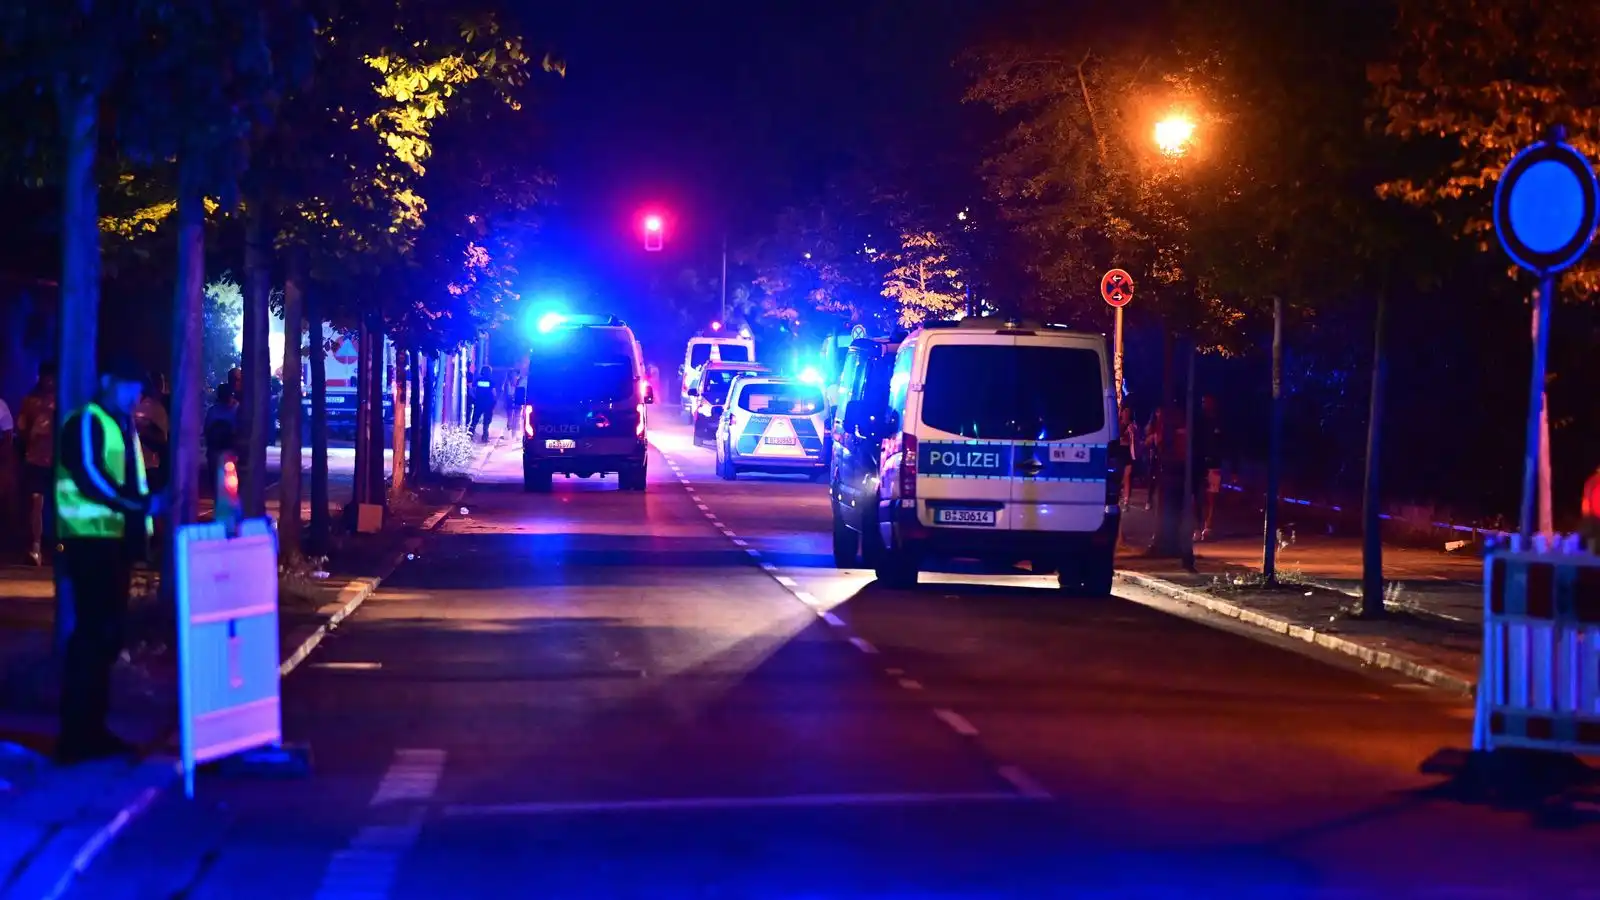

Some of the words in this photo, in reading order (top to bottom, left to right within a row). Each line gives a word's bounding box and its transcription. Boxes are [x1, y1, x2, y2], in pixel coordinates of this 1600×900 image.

[539, 424, 579, 433] POLIZEI
[930, 451, 999, 468] POLIZEI
[1075, 451, 1086, 459] 42
